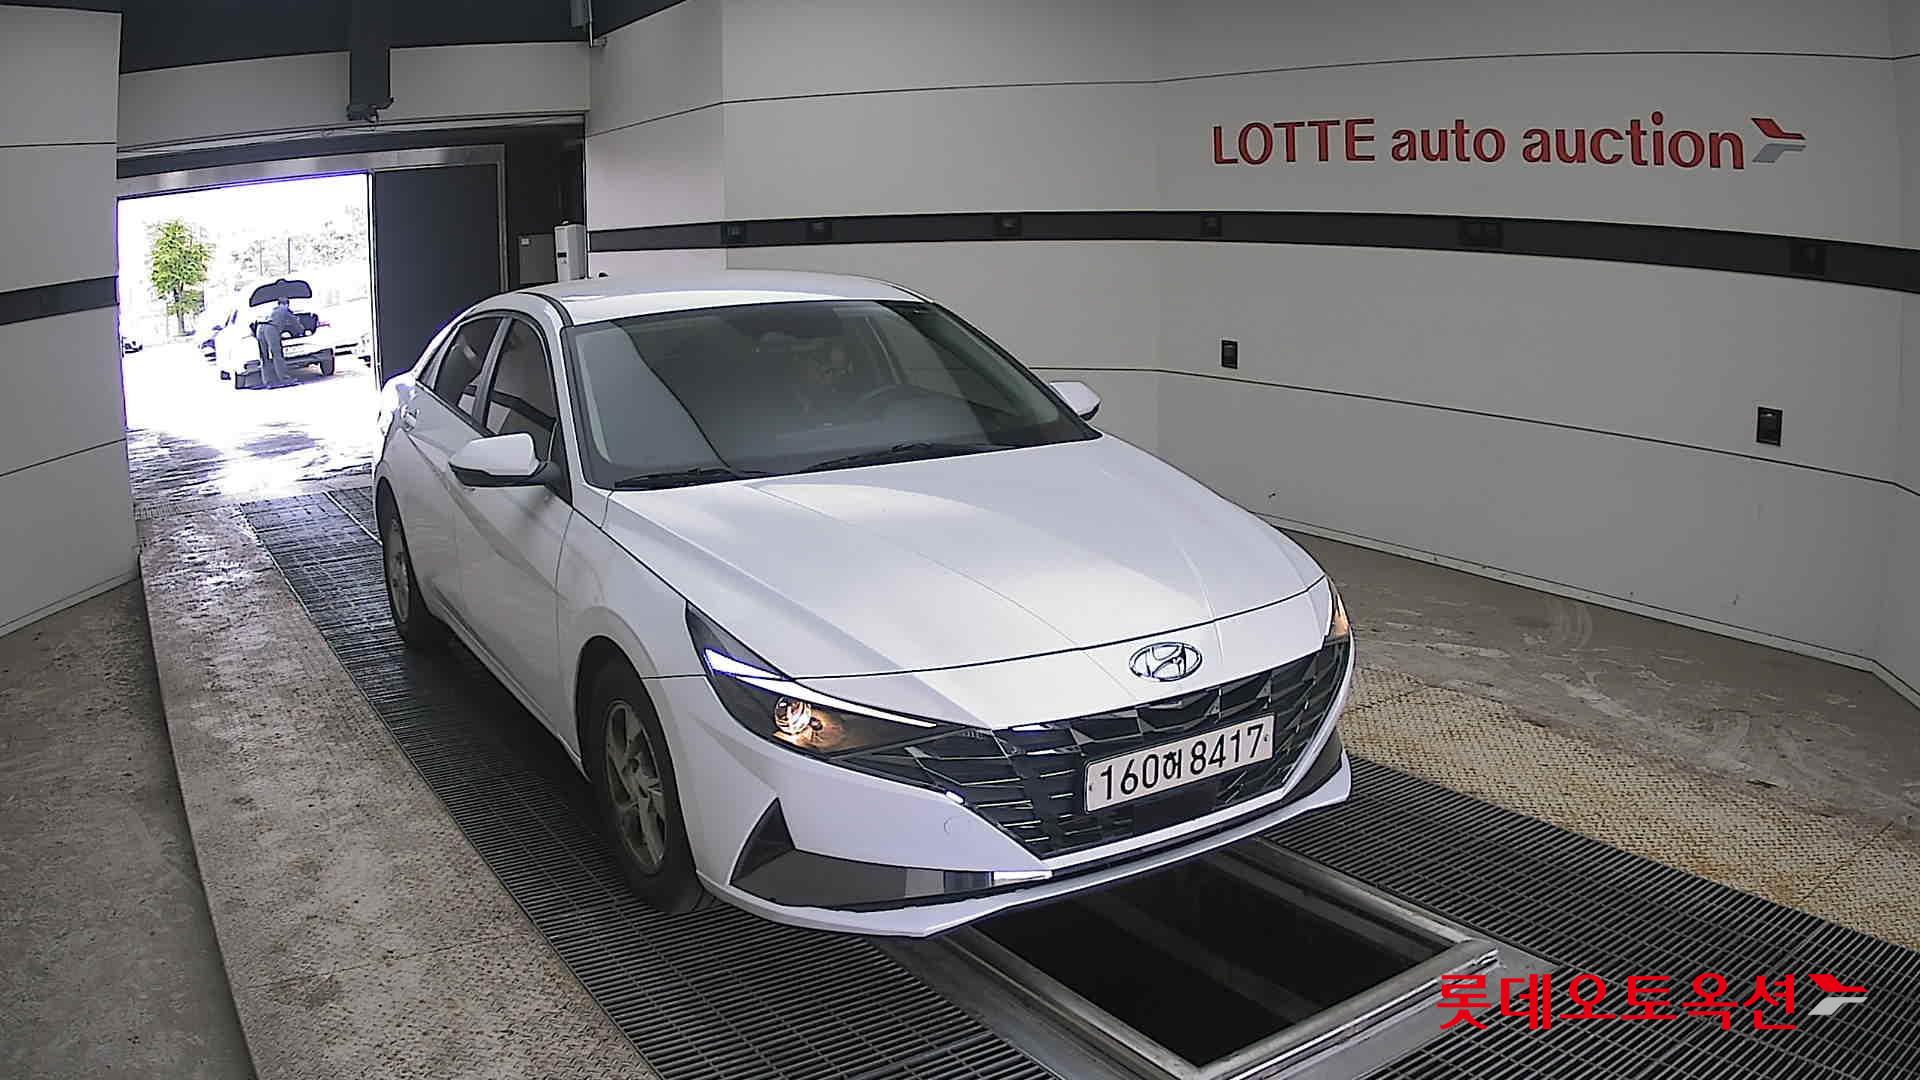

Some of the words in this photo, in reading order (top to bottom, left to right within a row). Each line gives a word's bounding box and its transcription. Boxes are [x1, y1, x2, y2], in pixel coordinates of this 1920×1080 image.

[1213, 118, 1375, 165] LOTTE
[1392, 118, 1506, 163] auto
[1522, 111, 1744, 170] auction
[1190, 723, 1264, 775] 8417
